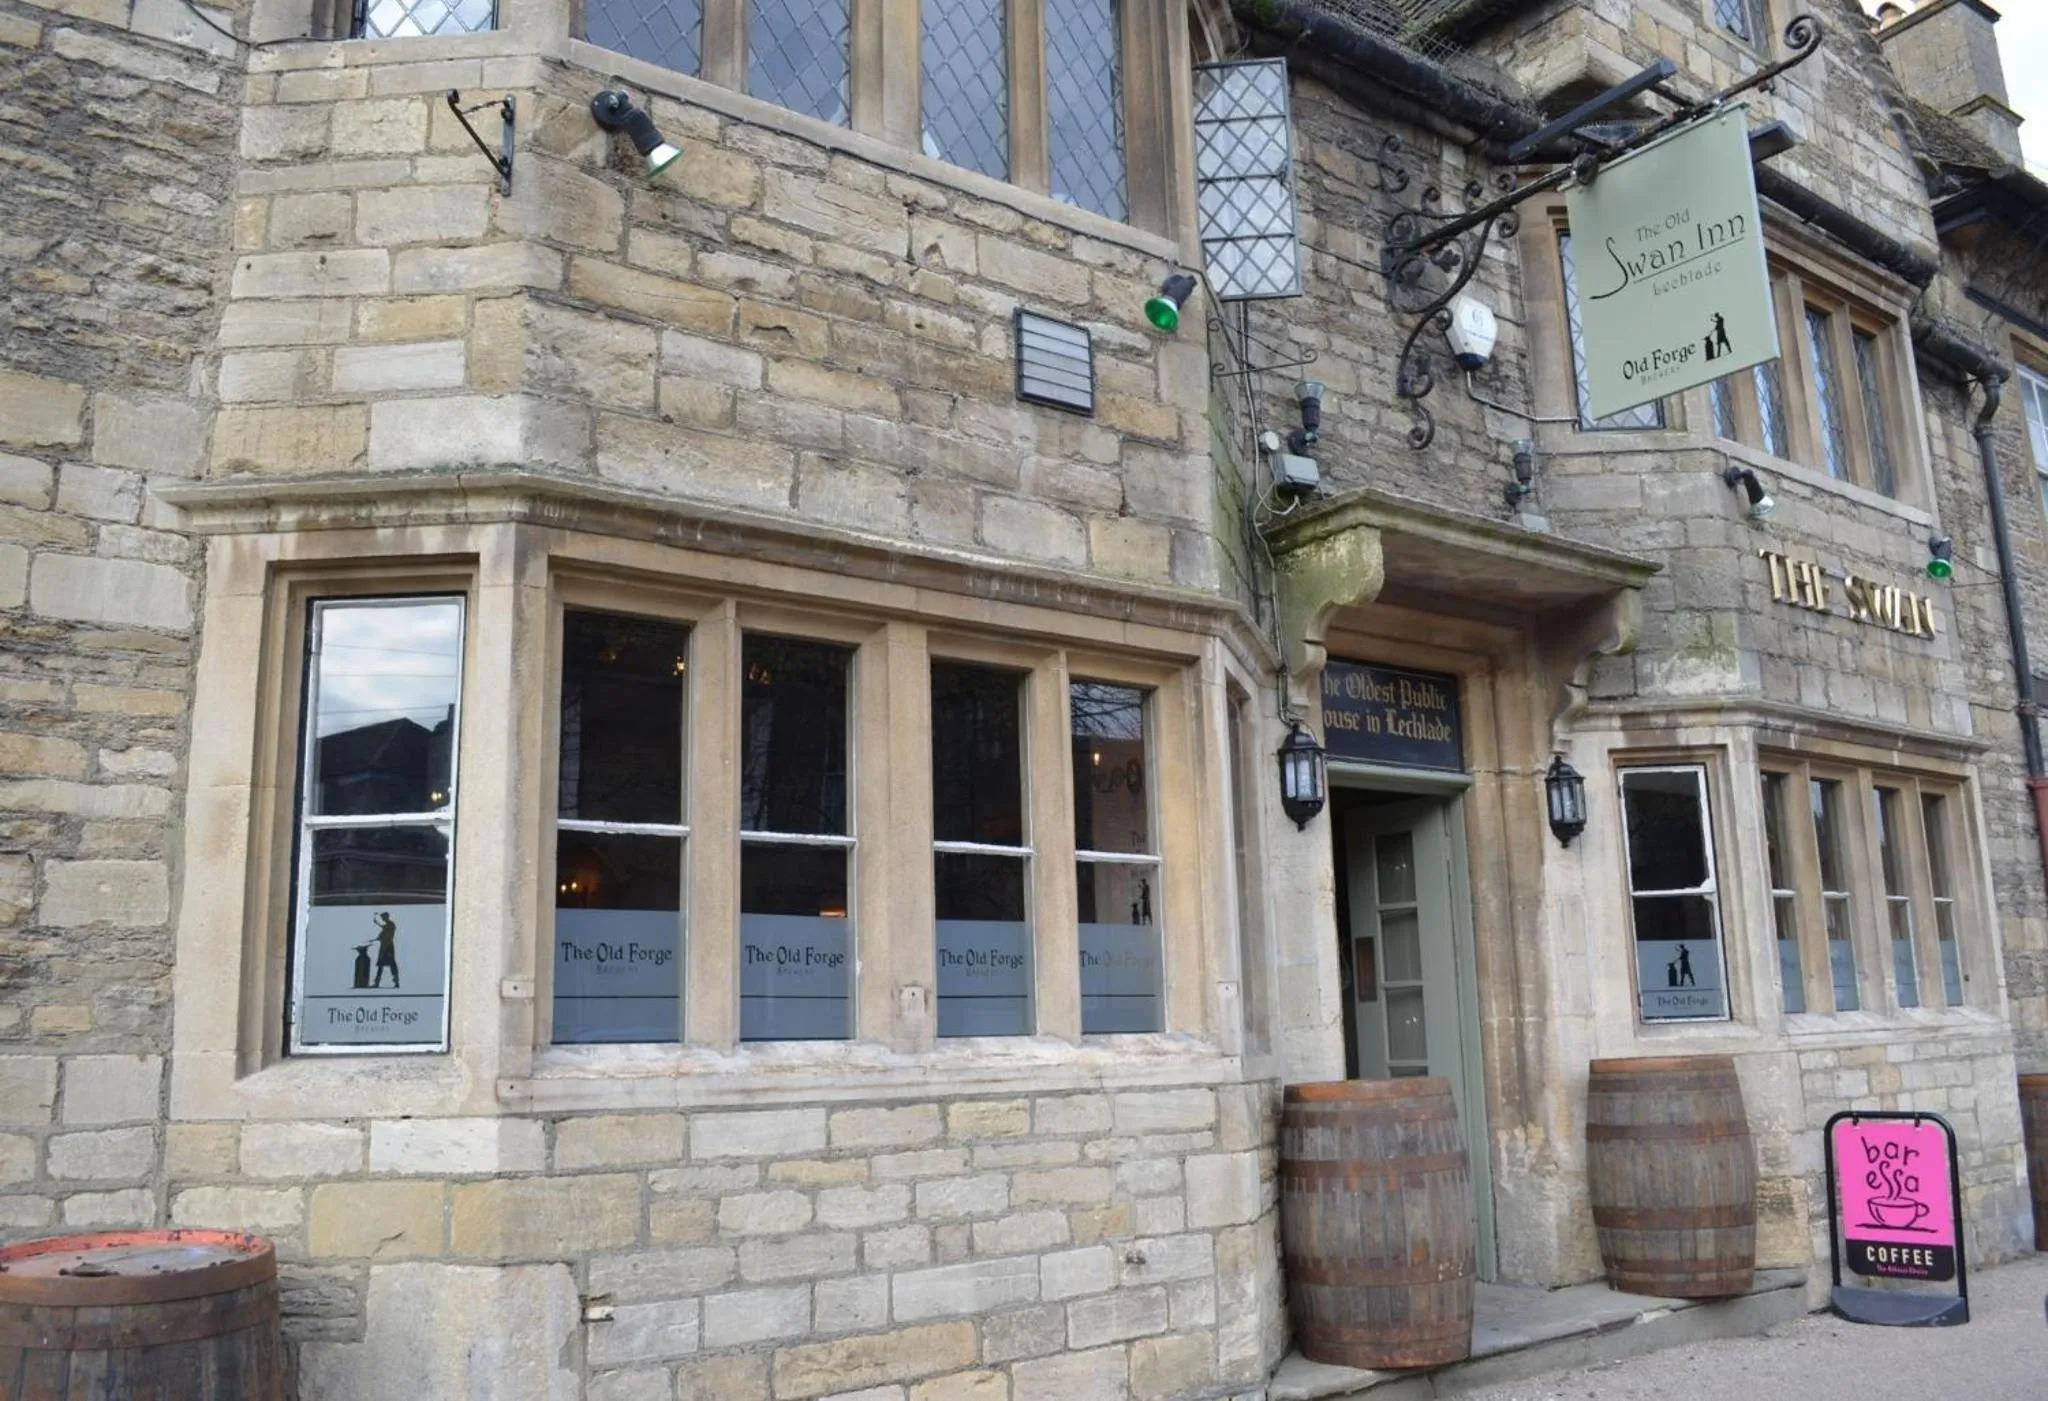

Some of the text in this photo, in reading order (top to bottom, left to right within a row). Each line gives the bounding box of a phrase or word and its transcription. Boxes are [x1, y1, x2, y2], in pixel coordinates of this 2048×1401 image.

[1635, 208, 1691, 242] The Old
[1589, 214, 1746, 300] Swan Inn
[1622, 343, 1697, 380] Old Forge
[1322, 668, 1448, 711] he Oldest Public
[1322, 707, 1452, 743] ouse in Lechlade
[561, 941, 673, 966] The Old Forge
[744, 944, 845, 969] The Old Forge
[939, 948, 1024, 970] The Old Forge
[327, 1006, 419, 1025] The Old Forge
[1860, 1136, 1920, 1166] bar
[1866, 1245, 1934, 1267] COFFEE
